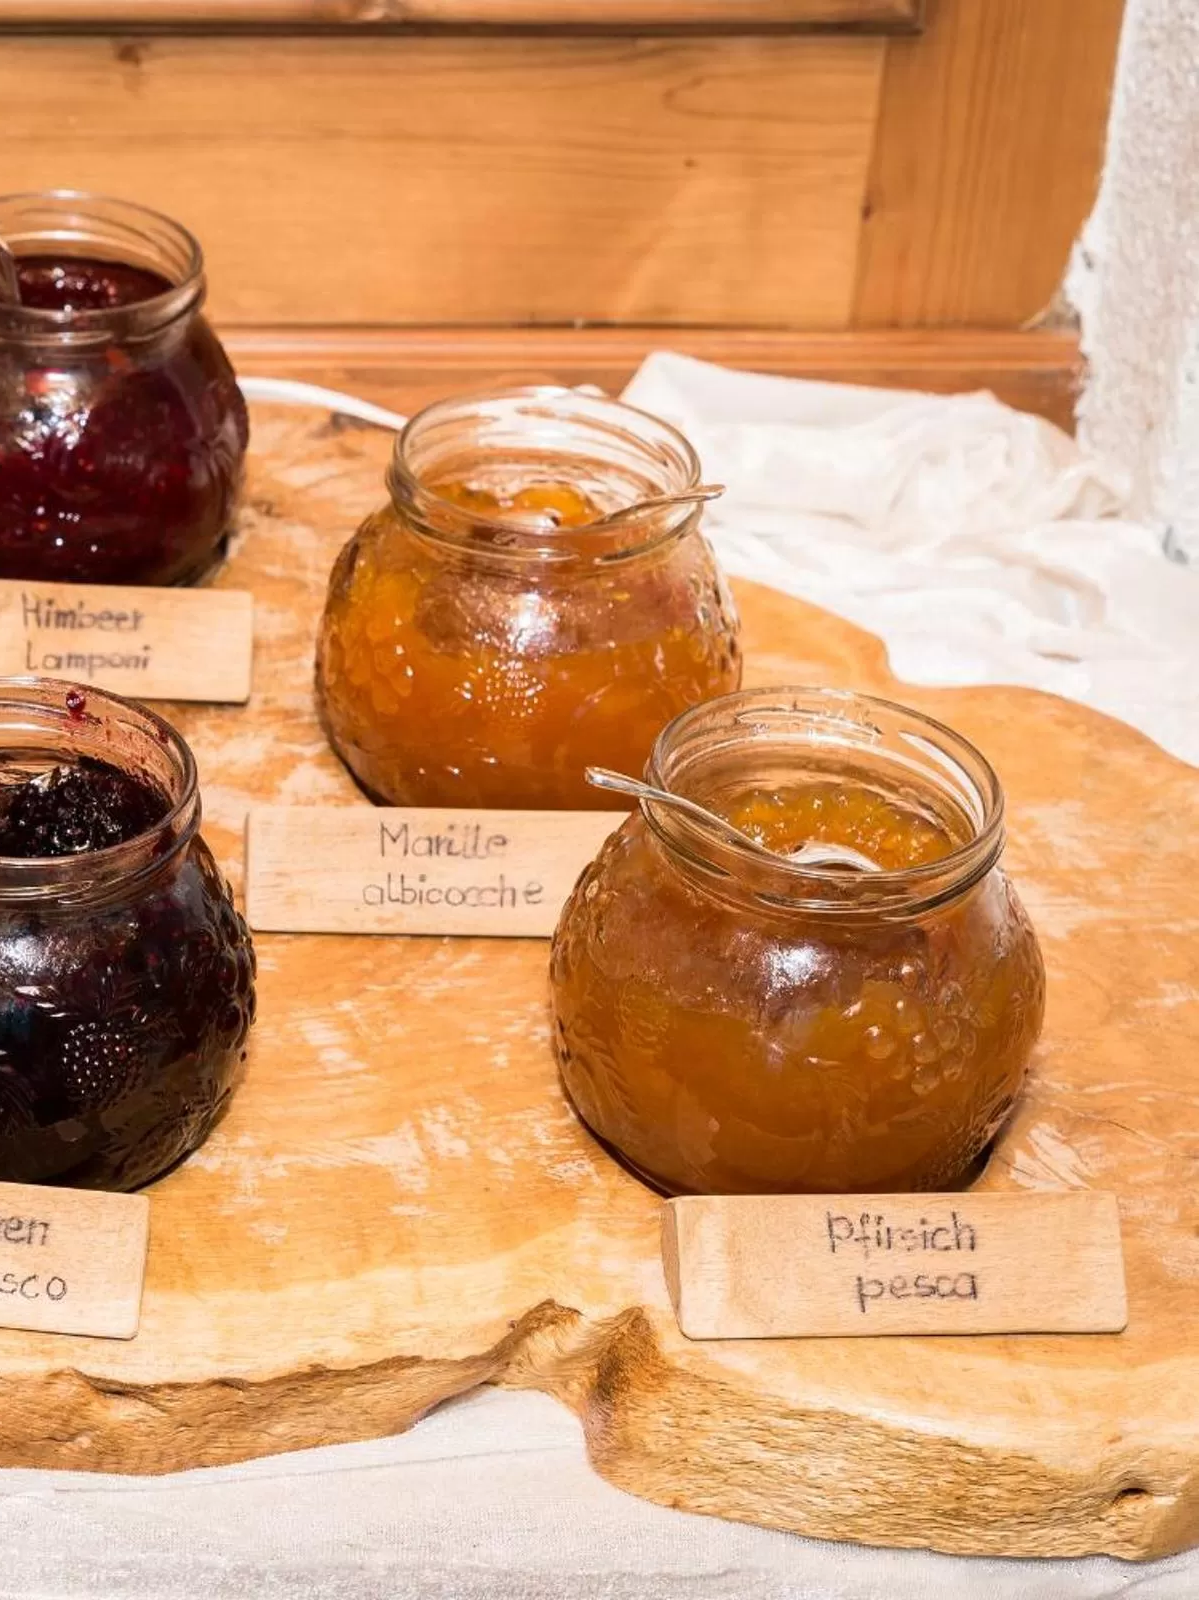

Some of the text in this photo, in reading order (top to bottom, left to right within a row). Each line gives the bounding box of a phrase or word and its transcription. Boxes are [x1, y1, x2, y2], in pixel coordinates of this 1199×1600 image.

[379, 821, 510, 859] Marille
[362, 872, 544, 908] albicocche
[856, 1273, 978, 1313] pesca
